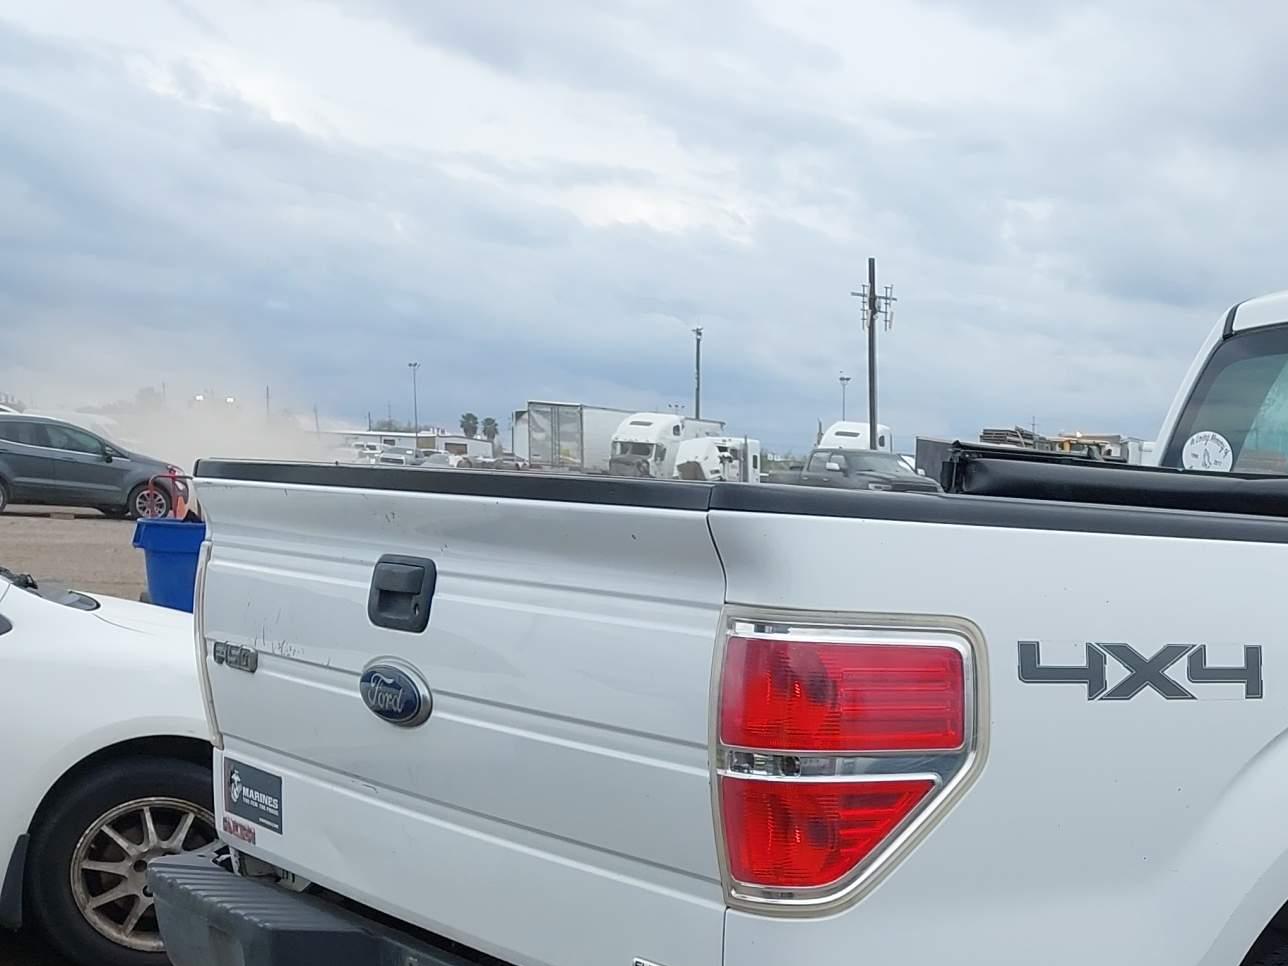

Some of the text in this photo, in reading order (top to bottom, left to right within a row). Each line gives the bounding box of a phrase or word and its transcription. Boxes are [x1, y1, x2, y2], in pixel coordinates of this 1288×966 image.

[1017, 640, 1263, 701] 4X4
[367, 672, 407, 713] Ford
[242, 786, 279, 809] MARINES
